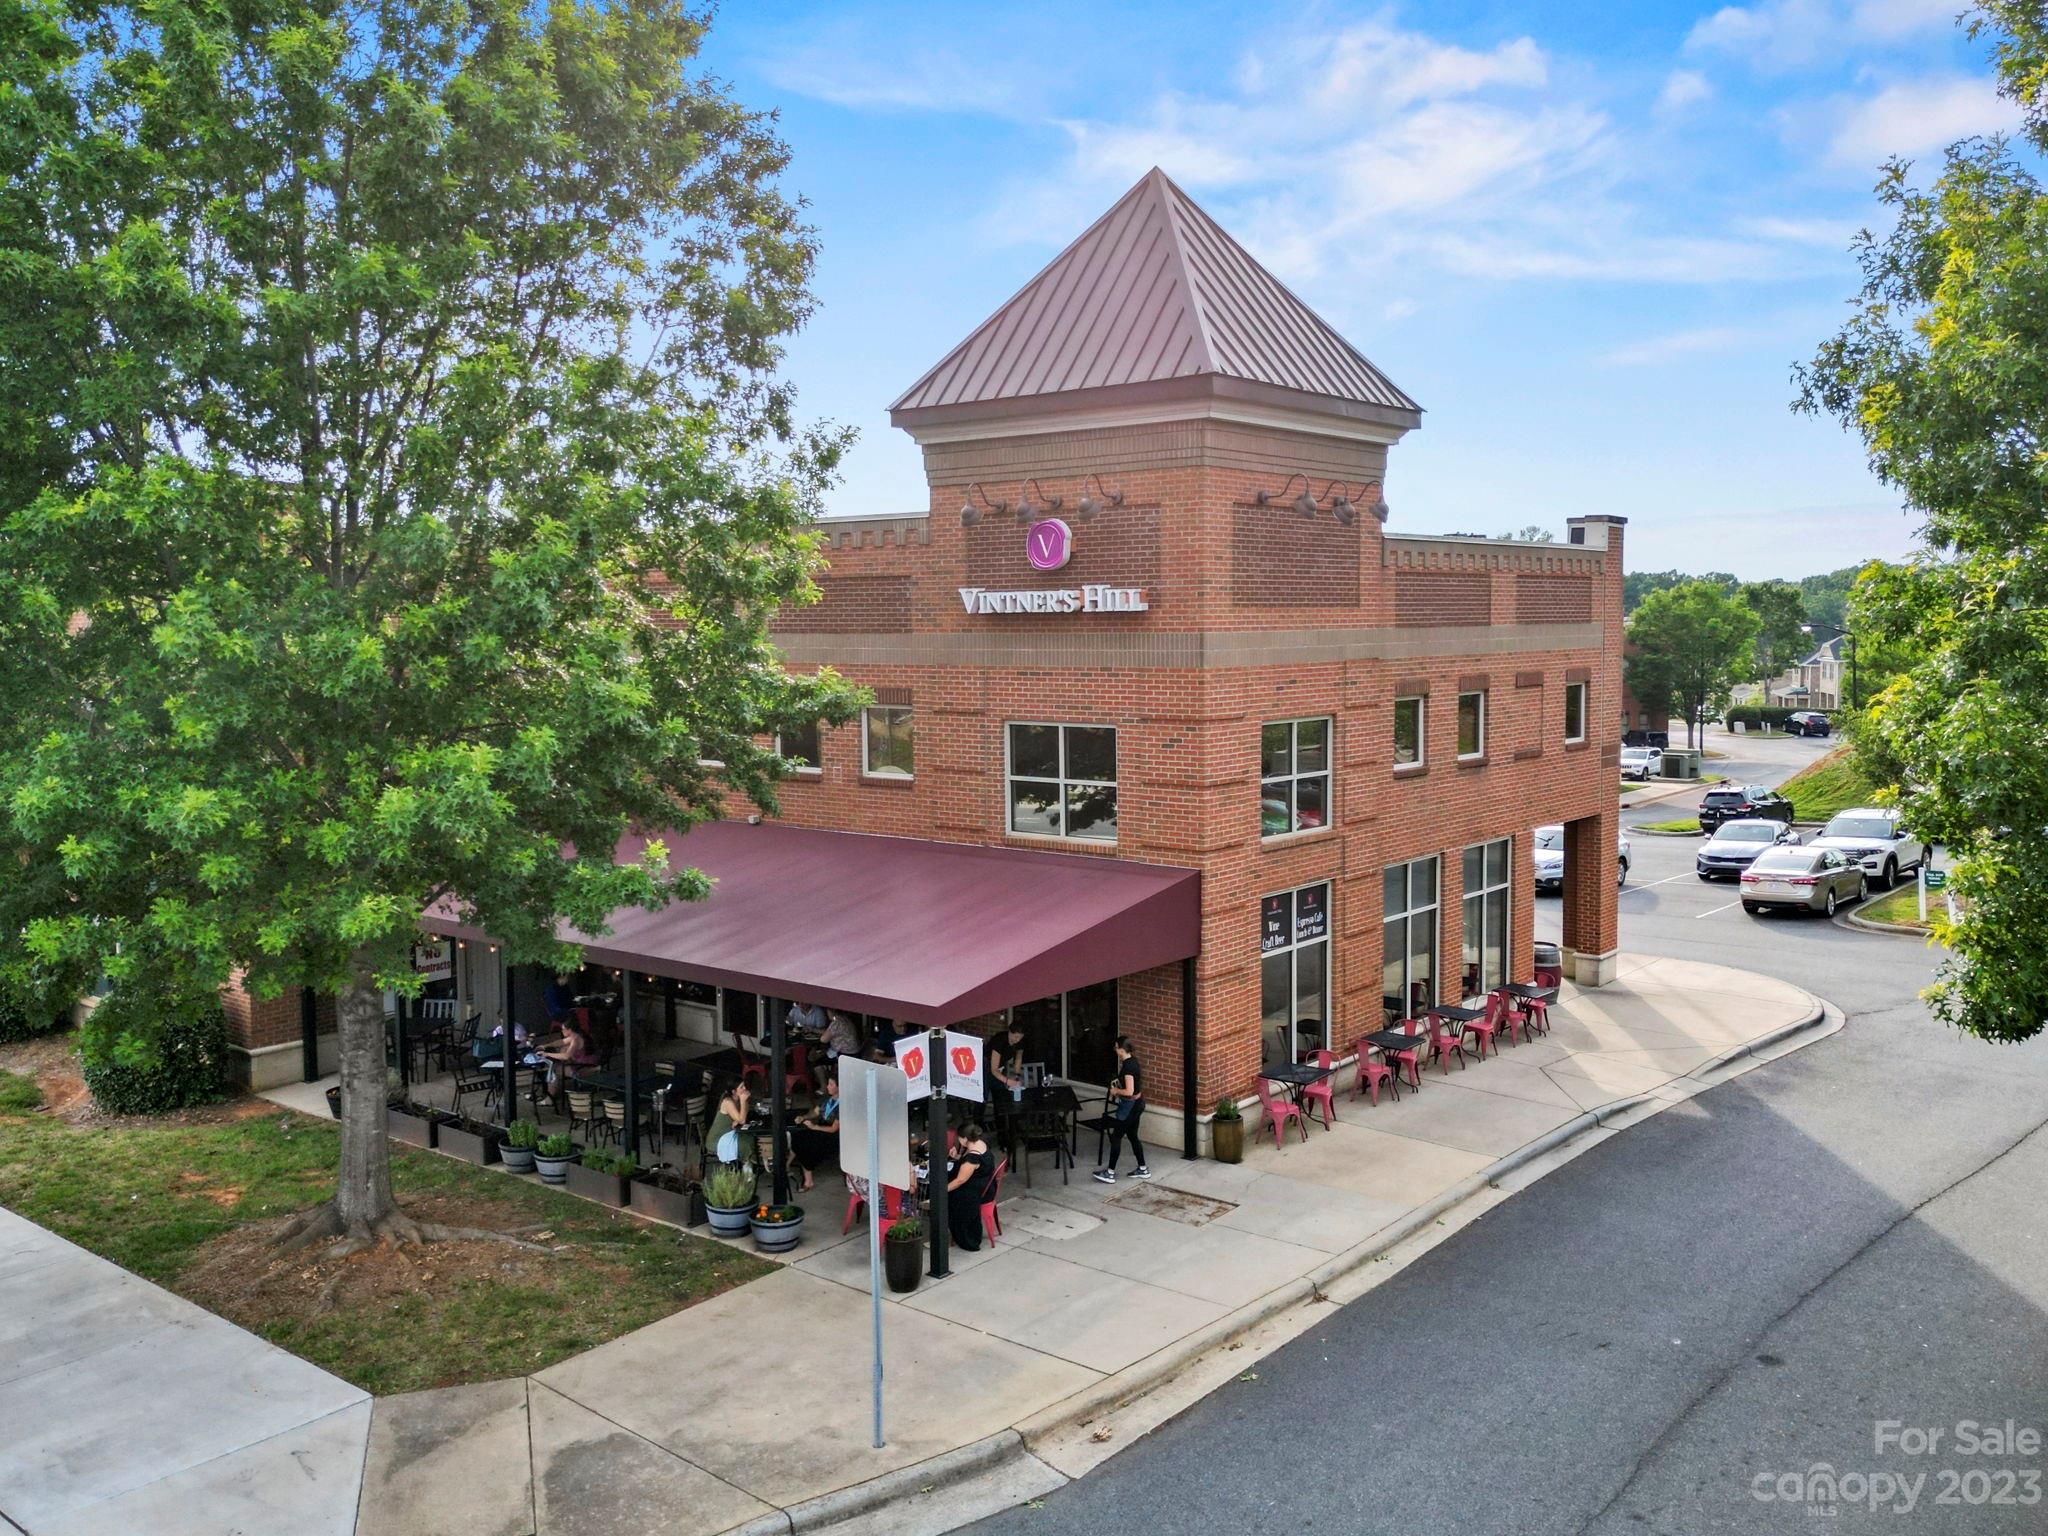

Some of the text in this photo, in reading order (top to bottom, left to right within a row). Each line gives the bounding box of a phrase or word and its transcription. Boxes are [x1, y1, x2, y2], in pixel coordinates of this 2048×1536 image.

[1038, 533, 1055, 559] V
[958, 584, 1149, 614] VINTNER'S HILL
[909, 1056, 918, 1073] V
[959, 1054, 970, 1072] V
